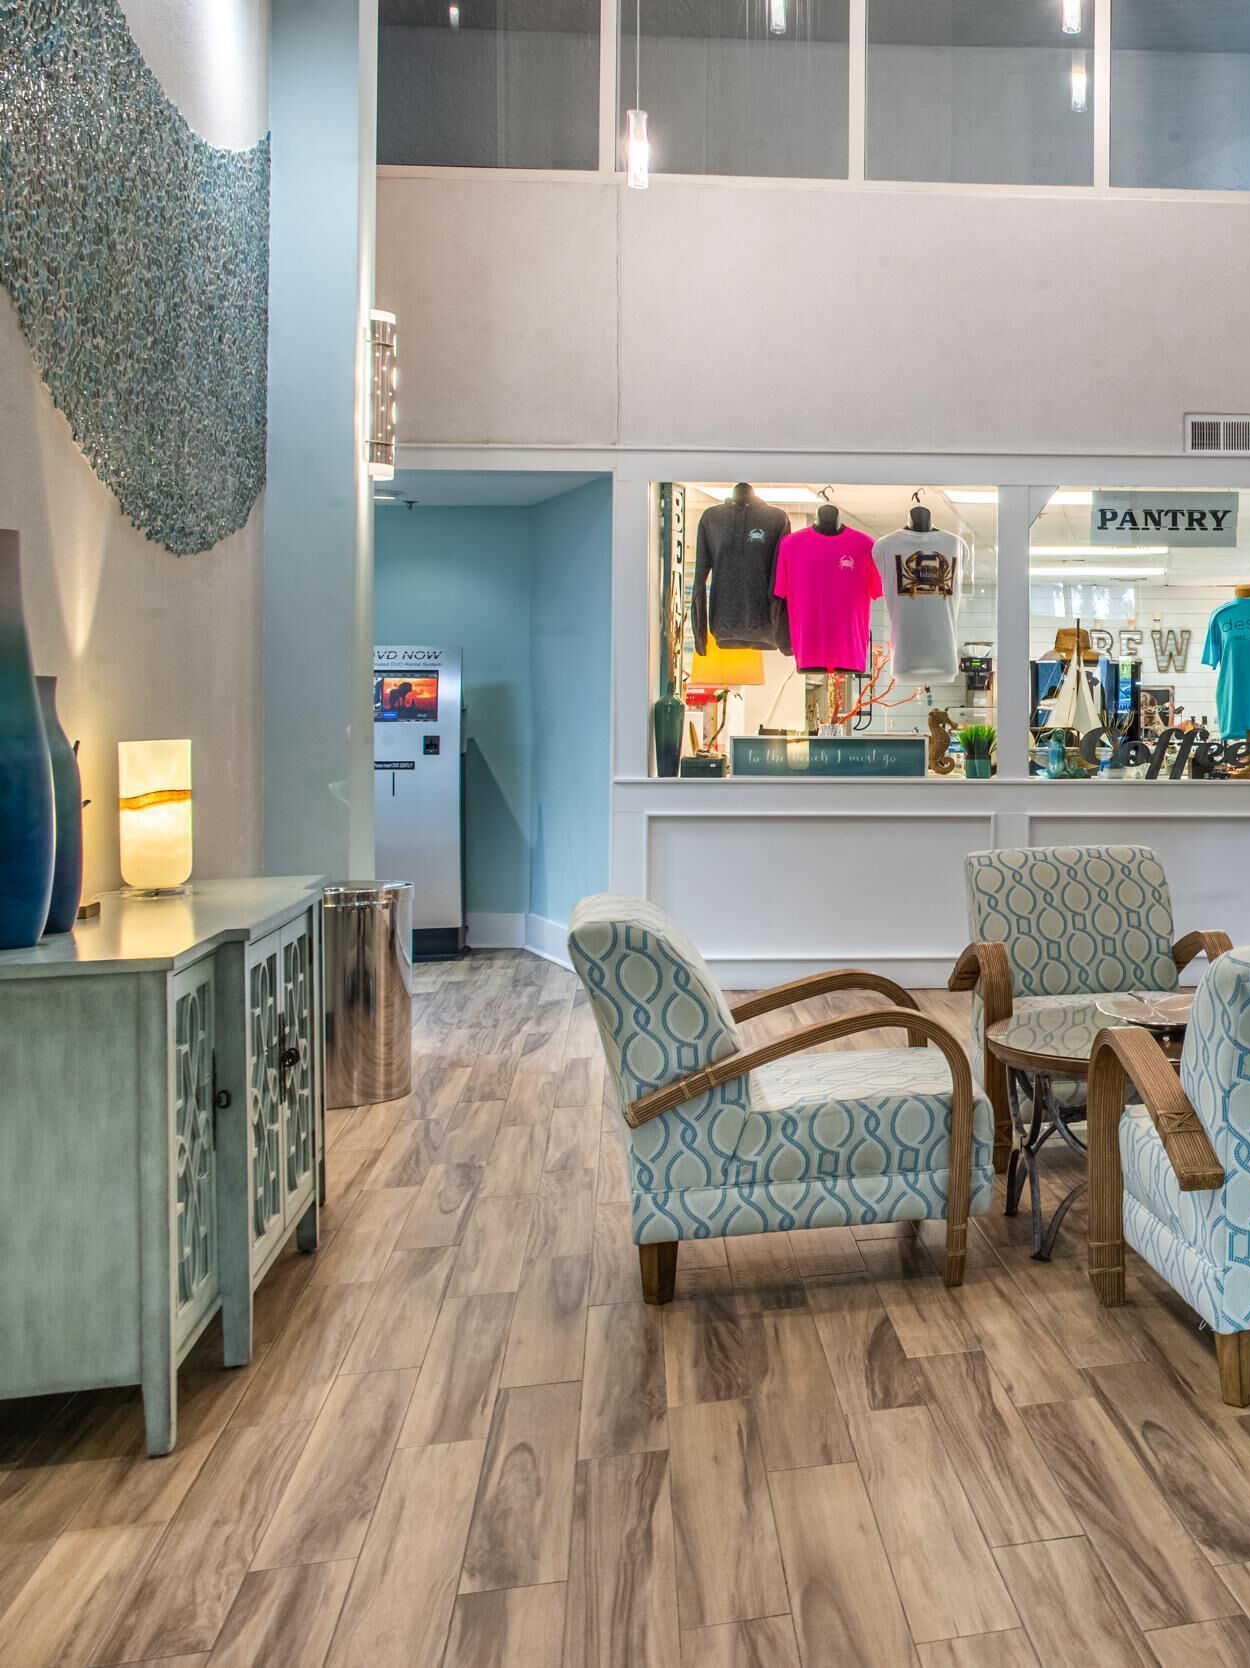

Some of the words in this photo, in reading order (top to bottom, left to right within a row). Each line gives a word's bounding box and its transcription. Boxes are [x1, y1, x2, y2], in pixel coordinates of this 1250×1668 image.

[1097, 508, 1233, 531] PANTRY
[374, 651, 398, 660] VD
[402, 651, 443, 660] NOW
[766, 749, 785, 764] the
[836, 749, 842, 763] I
[849, 749, 877, 763] must
